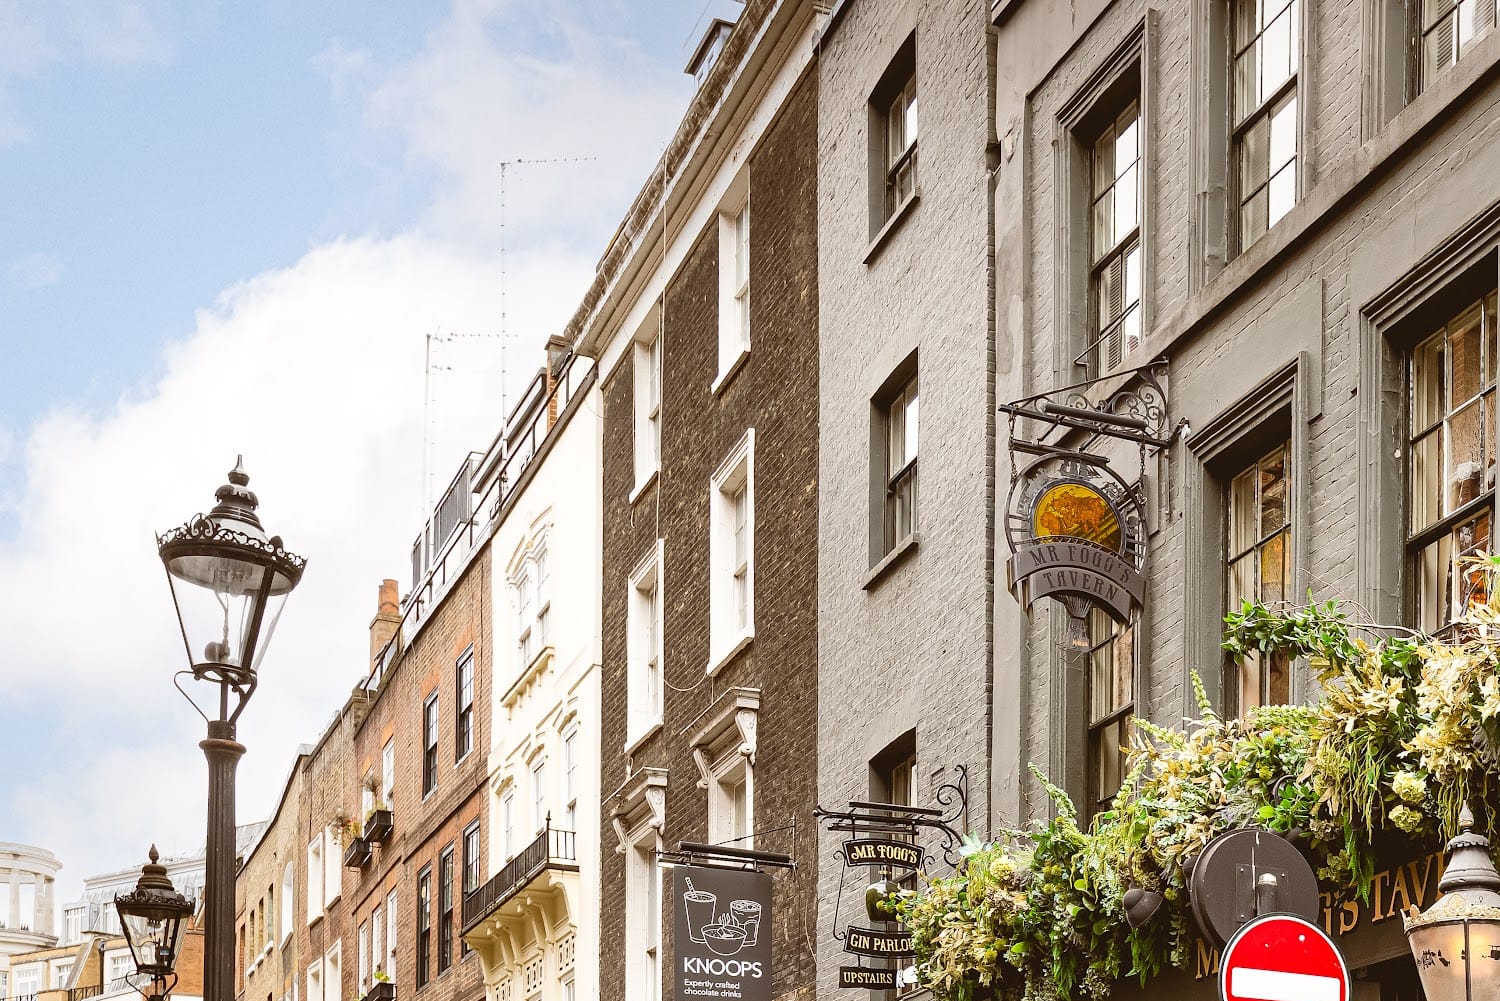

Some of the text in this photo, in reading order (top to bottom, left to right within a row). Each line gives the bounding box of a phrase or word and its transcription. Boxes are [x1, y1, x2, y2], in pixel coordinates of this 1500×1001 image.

[1029, 545, 1132, 585] MR FOGG'S
[1043, 570, 1119, 601] TAVERN
[851, 844, 918, 865] MR FOGG'S
[850, 933, 914, 952] GIN PARLOU
[684, 956, 763, 979] KNOOPS
[843, 971, 893, 984] UPSTAIRS
[684, 978, 740, 990] Expertly crafted
[684, 987, 742, 998] chocolate drinks
